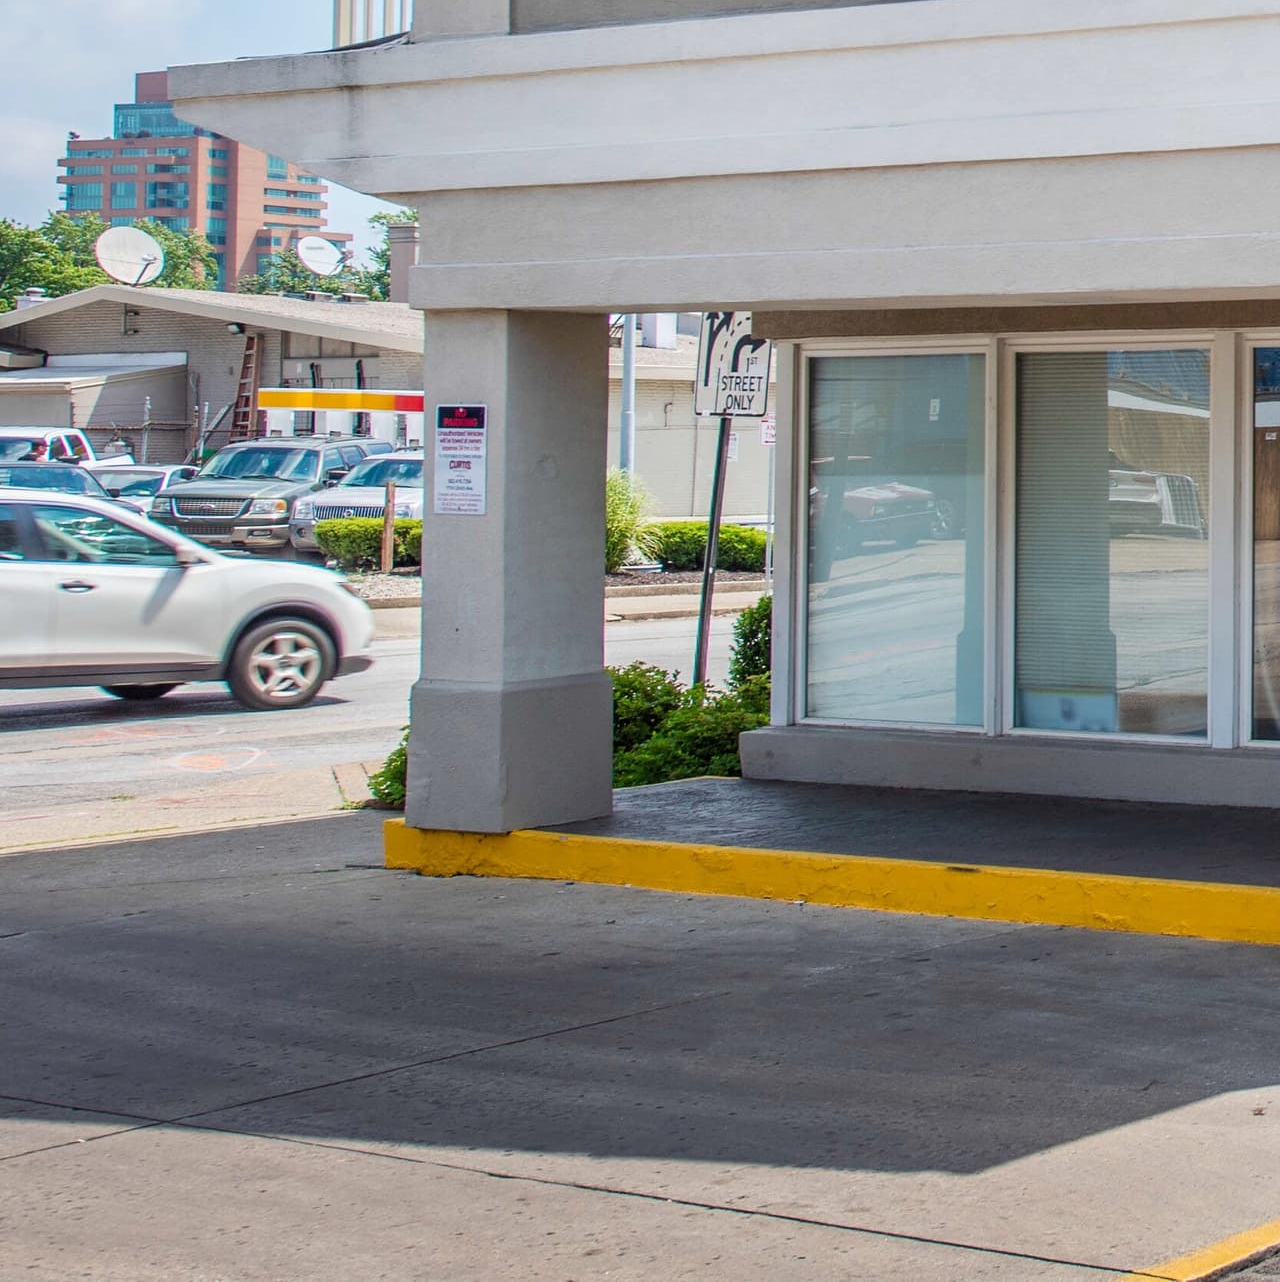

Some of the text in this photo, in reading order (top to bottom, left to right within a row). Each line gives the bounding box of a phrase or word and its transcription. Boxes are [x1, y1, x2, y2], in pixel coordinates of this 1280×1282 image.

[721, 375, 763, 392] STREET
[725, 394, 755, 410] ONLY
[443, 417, 478, 427] PARKING
[449, 460, 472, 469] CURTIS
